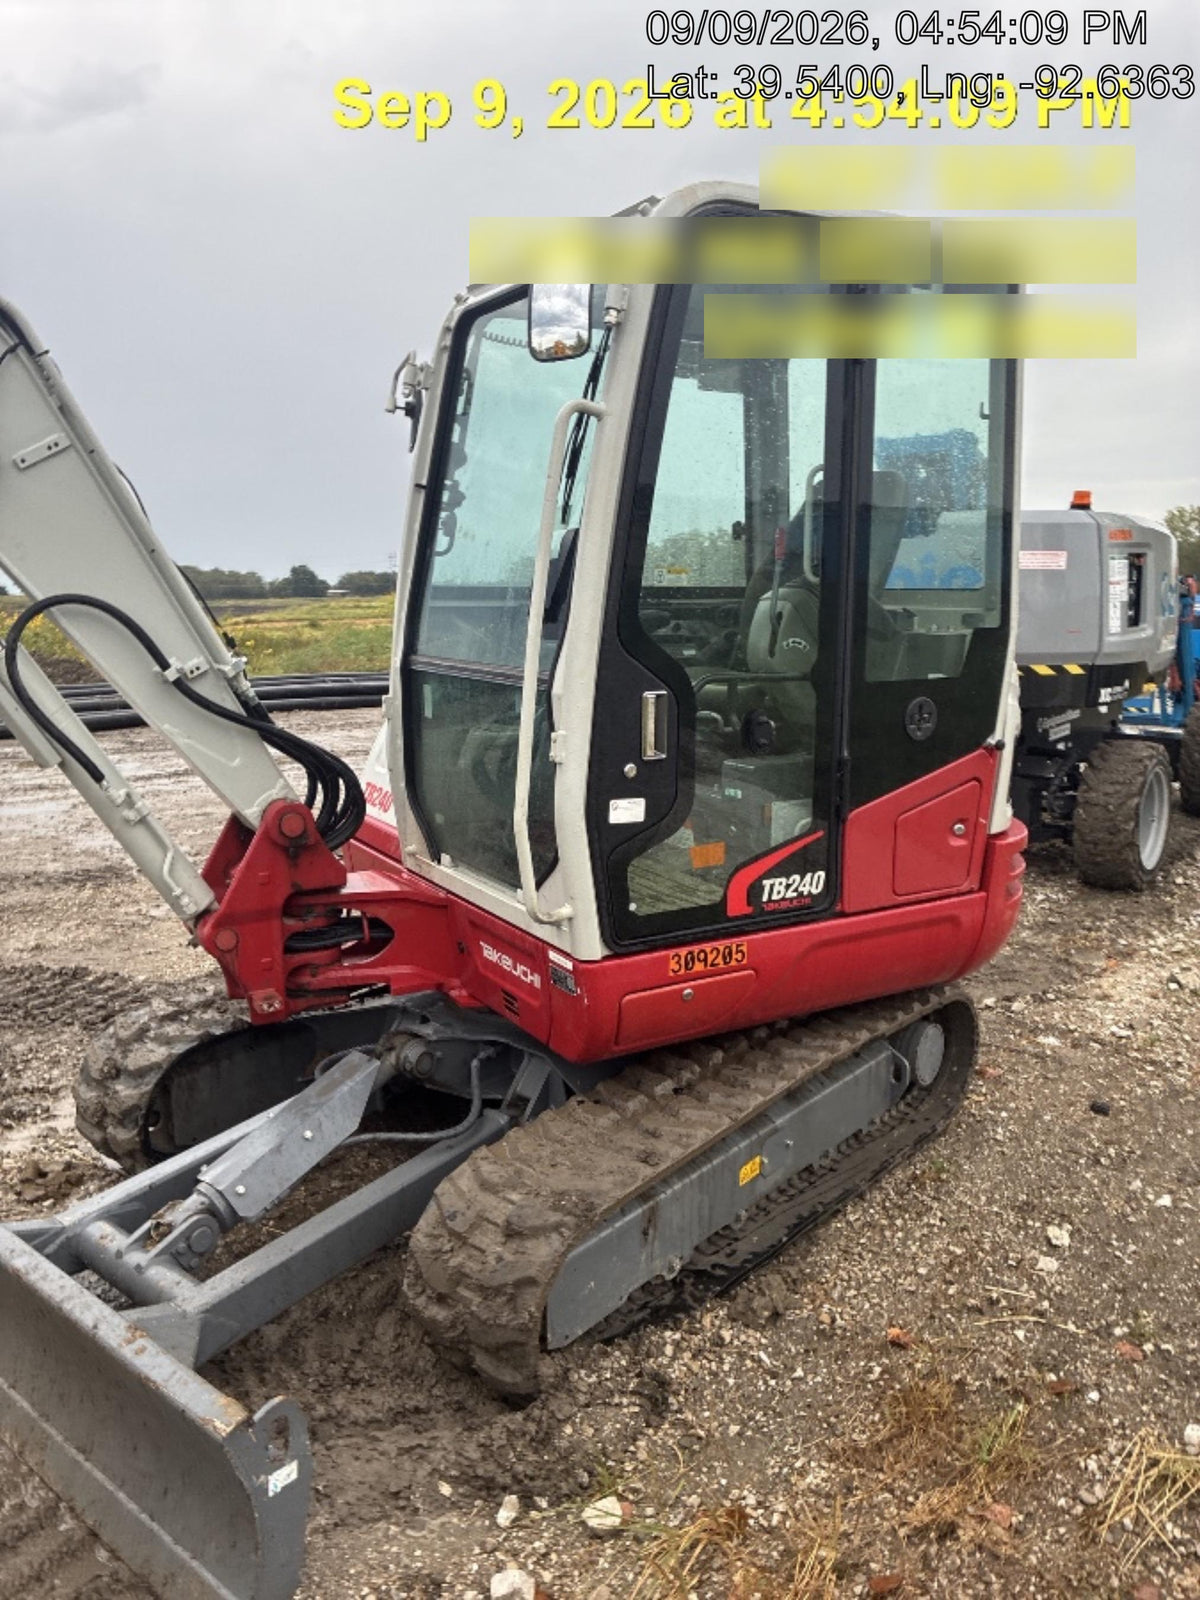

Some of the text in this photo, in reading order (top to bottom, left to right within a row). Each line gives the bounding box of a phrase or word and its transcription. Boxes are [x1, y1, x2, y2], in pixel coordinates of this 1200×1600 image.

[364, 781, 393, 814] TB240
[761, 870, 826, 902] TB240
[671, 943, 746, 974] 309205
